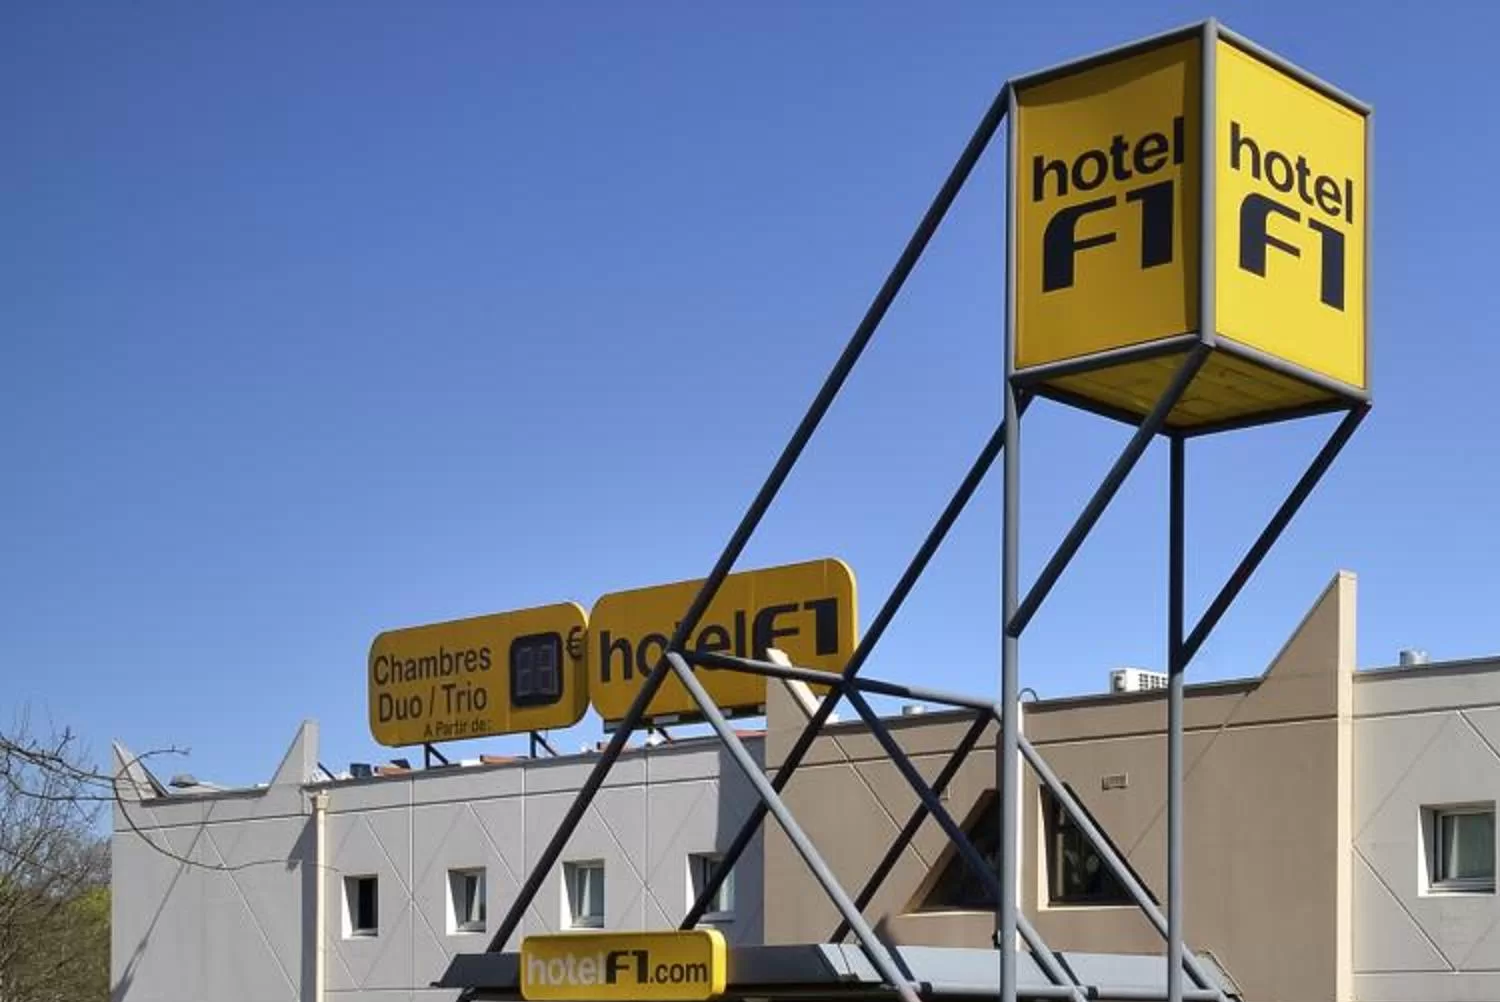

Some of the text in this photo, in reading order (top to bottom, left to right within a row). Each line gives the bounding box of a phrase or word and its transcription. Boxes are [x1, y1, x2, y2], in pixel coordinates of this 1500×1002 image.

[1033, 115, 1184, 202] hotel
[1230, 120, 1353, 224] hotel
[1042, 179, 1174, 293] F1
[1238, 191, 1345, 312] F1
[373, 646, 492, 685] Chambres
[600, 597, 838, 683] hoelF1
[379, 693, 423, 723] Duo
[441, 681, 487, 714] Trio
